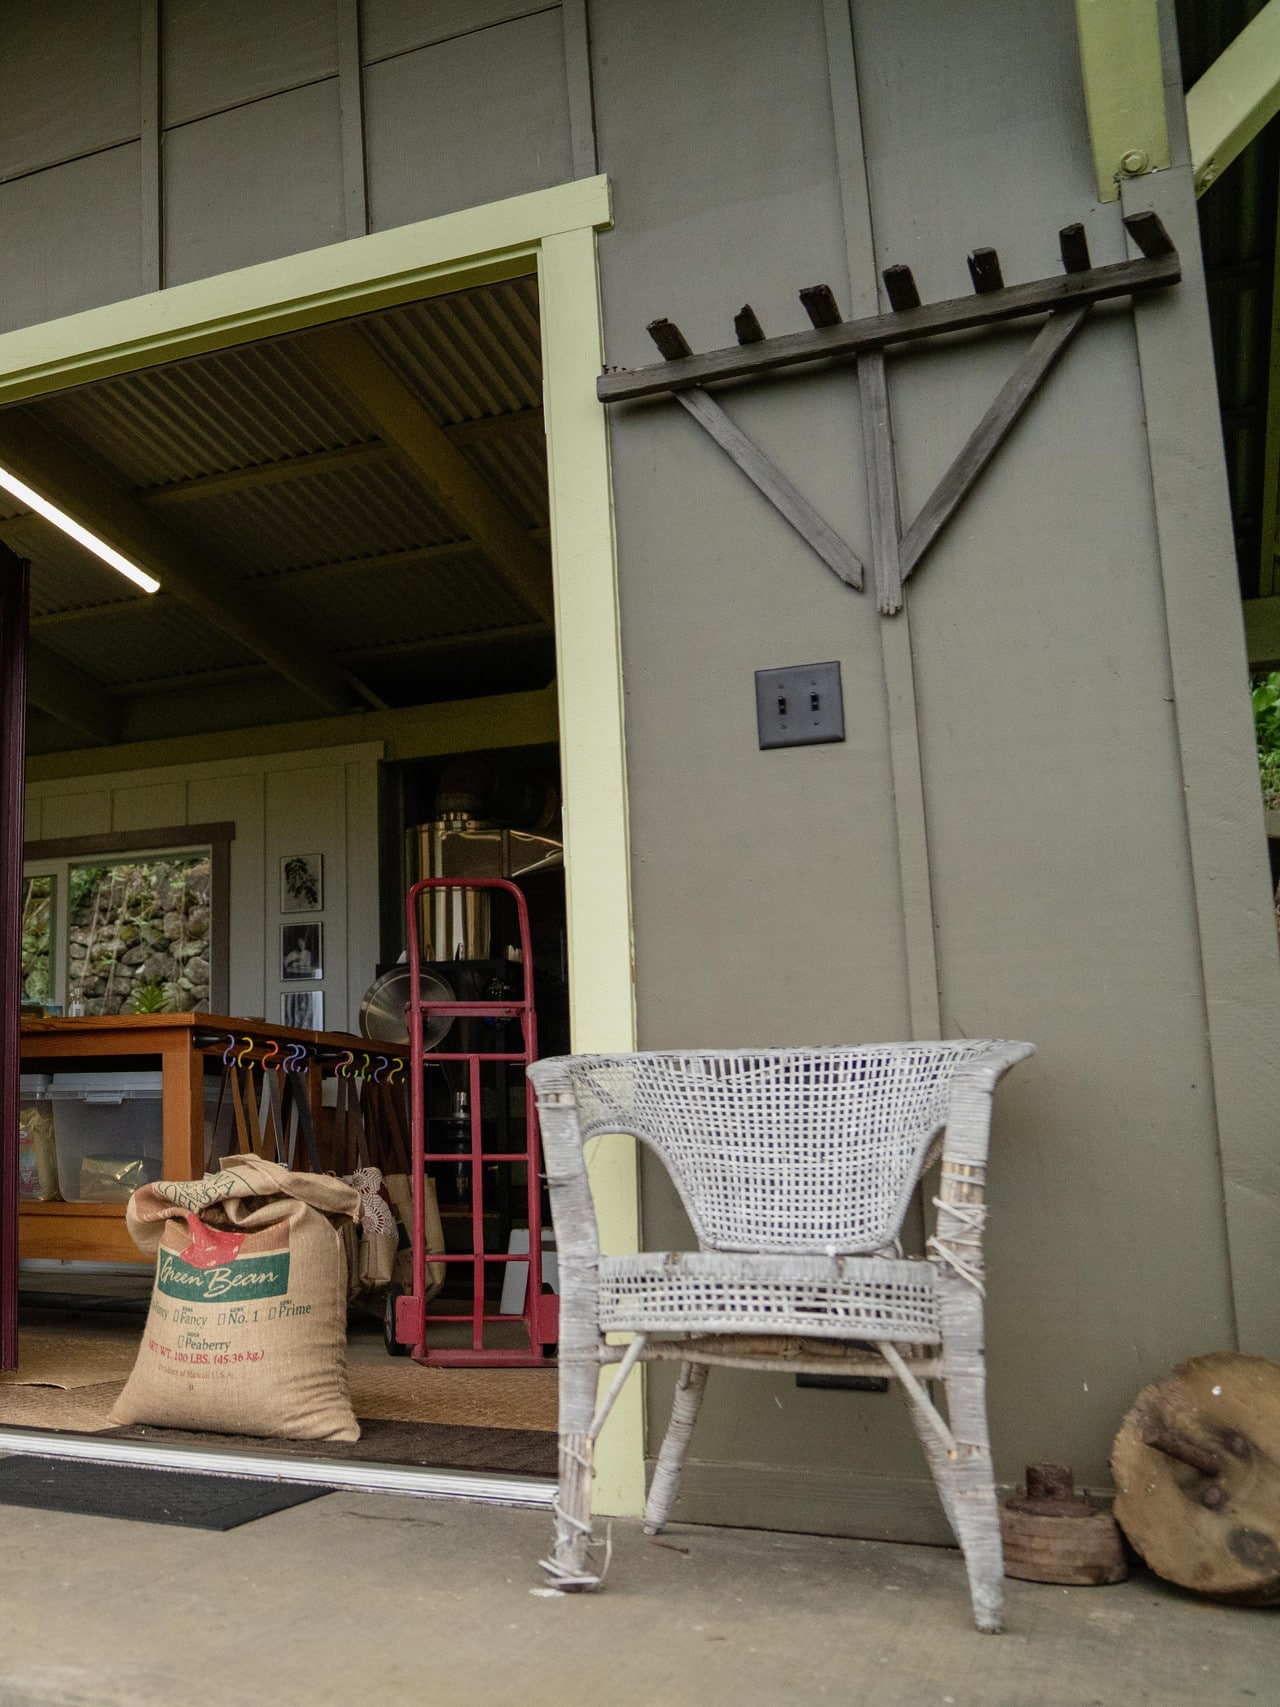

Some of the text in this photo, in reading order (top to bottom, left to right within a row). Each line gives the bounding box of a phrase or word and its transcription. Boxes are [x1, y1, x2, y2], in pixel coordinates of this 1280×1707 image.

[160, 1256, 278, 1298] Green Bean
[179, 1311, 208, 1326] Fancy
[228, 1310, 259, 1325] No. 1
[278, 1304, 312, 1318] Prime
[185, 1336, 232, 1352] Peaberry
[174, 1352, 188, 1363] 100
[190, 1354, 210, 1364] LBS.
[214, 1352, 244, 1365] (45.36
[246, 1349, 265, 1362] kg.)
